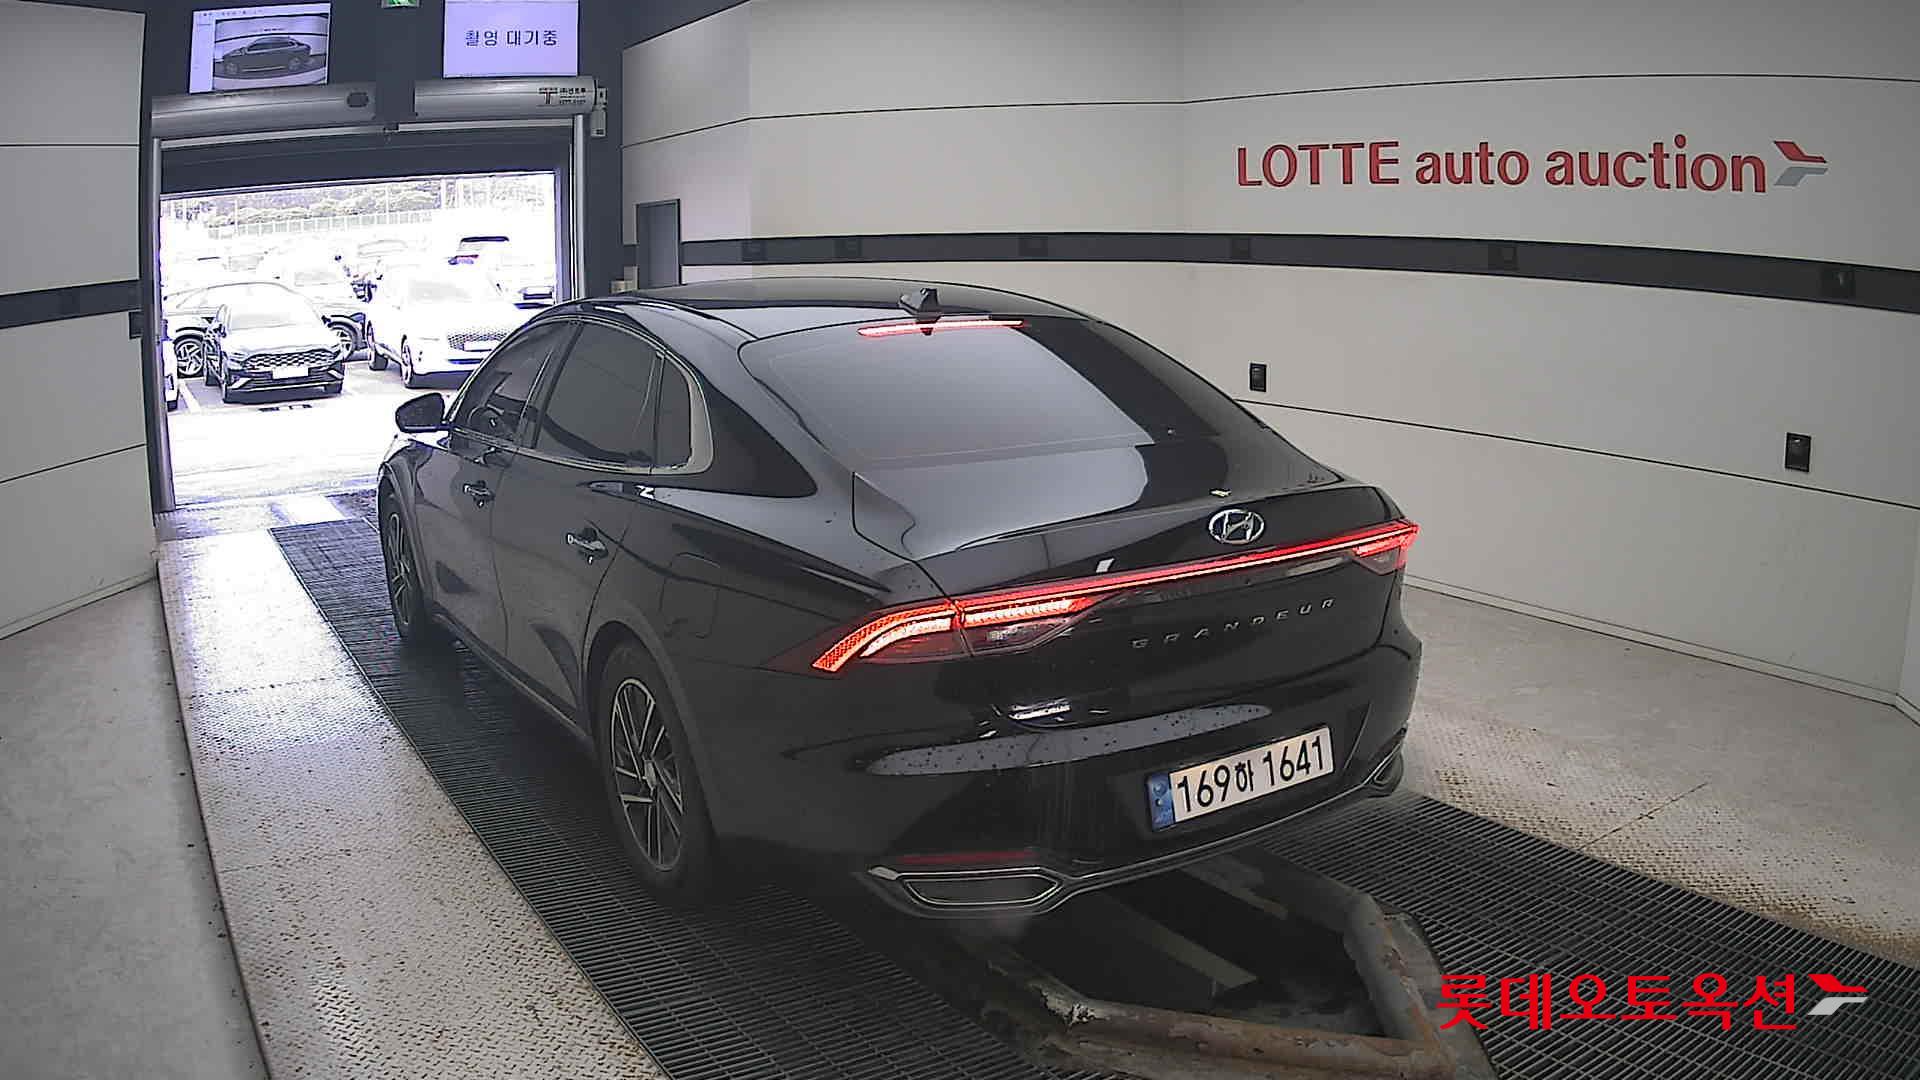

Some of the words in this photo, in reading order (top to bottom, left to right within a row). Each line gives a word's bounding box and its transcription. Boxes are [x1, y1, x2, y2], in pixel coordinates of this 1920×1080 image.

[465, 29, 498, 47] 촬영
[506, 29, 558, 47] 대기중
[1237, 140, 1400, 187] LOTTE
[1415, 142, 1530, 186] auto
[1545, 134, 1767, 193] auction
[1131, 598, 1334, 648] GRANDEUR
[1177, 760, 1254, 812] 169하
[1263, 735, 1324, 787] 1641
